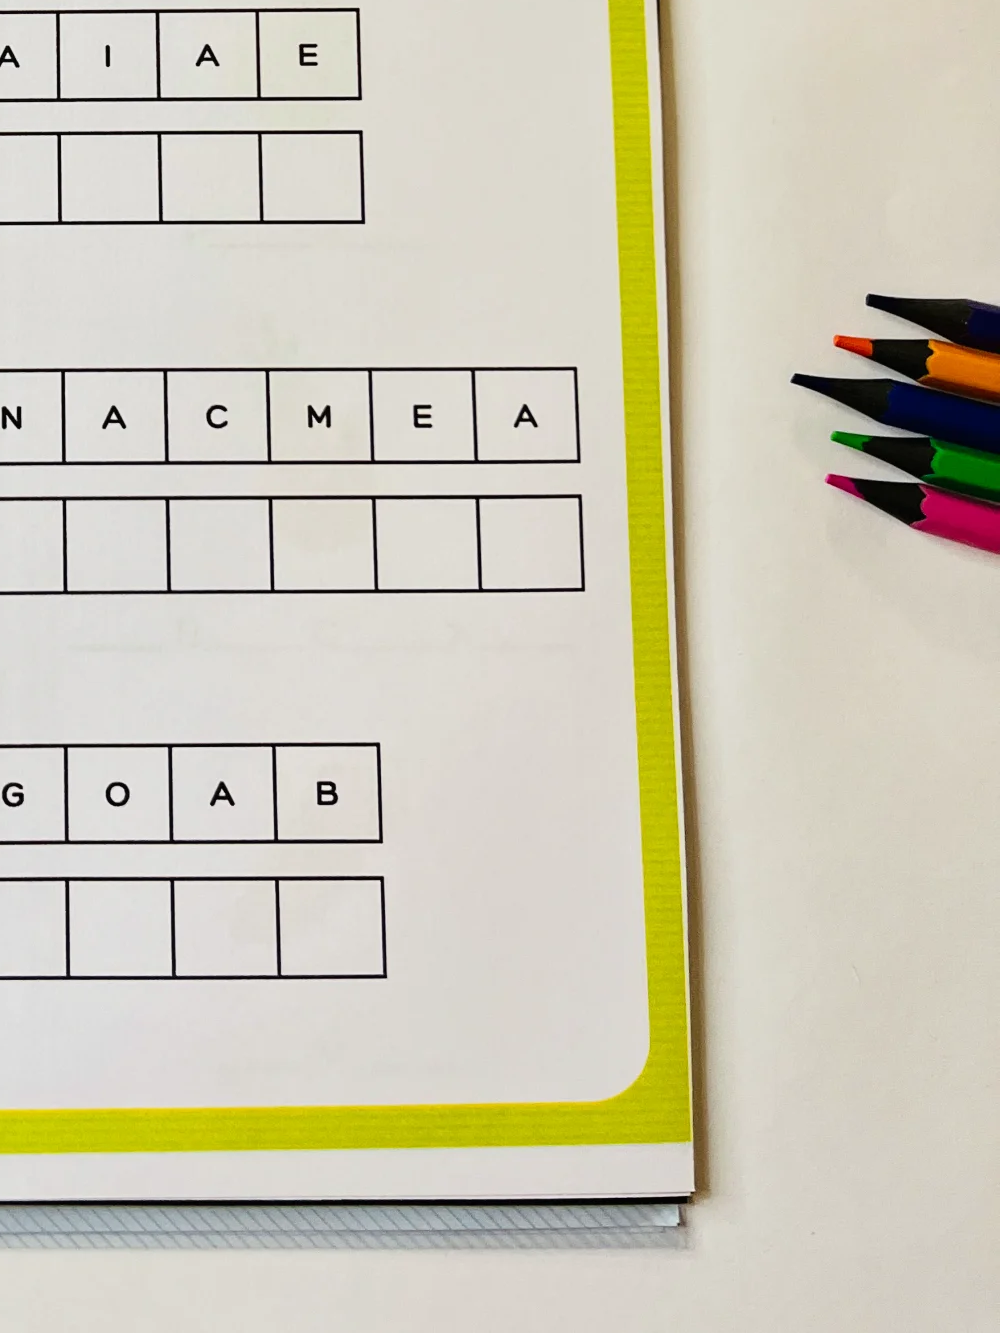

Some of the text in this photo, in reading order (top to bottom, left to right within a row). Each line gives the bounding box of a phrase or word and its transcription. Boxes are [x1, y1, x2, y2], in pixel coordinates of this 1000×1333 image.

[194, 43, 221, 68] A
[298, 43, 319, 67] E
[0, 405, 23, 431] N
[101, 404, 127, 430] A
[205, 404, 229, 430] C
[306, 404, 332, 429] M
[412, 403, 434, 429] E
[513, 403, 539, 429] A
[1, 781, 25, 808] G
[104, 781, 131, 808] O
[209, 780, 236, 807] A
[316, 780, 339, 806] B
